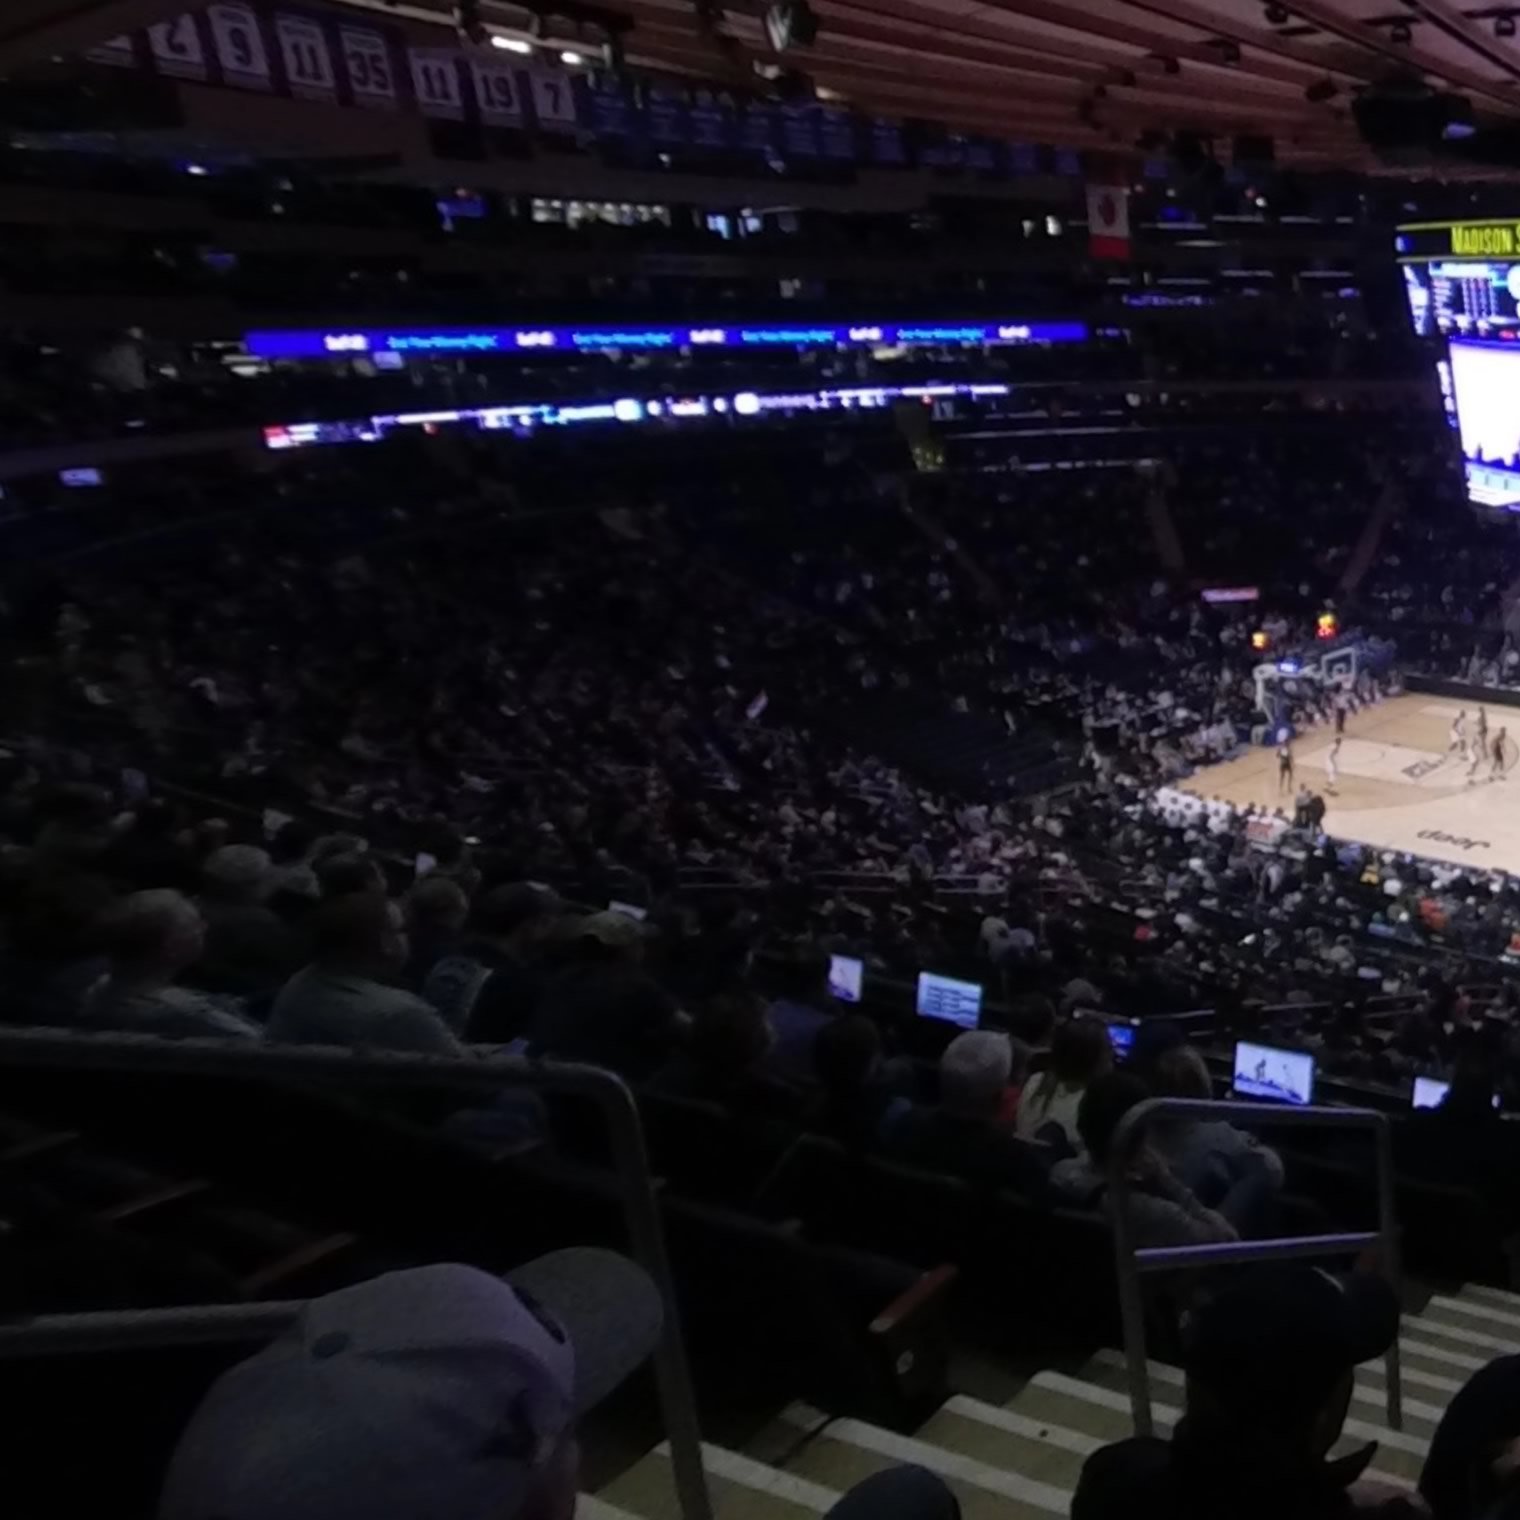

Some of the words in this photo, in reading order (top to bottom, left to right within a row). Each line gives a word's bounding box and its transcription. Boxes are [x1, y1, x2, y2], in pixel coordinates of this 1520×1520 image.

[229, 27, 252, 66] 9
[290, 42, 323, 81] 11
[348, 50, 389, 91] 35
[421, 63, 450, 100] 11
[481, 74, 515, 110] 19
[543, 82, 563, 116] 7
[1452, 226, 1513, 254] MADISON
